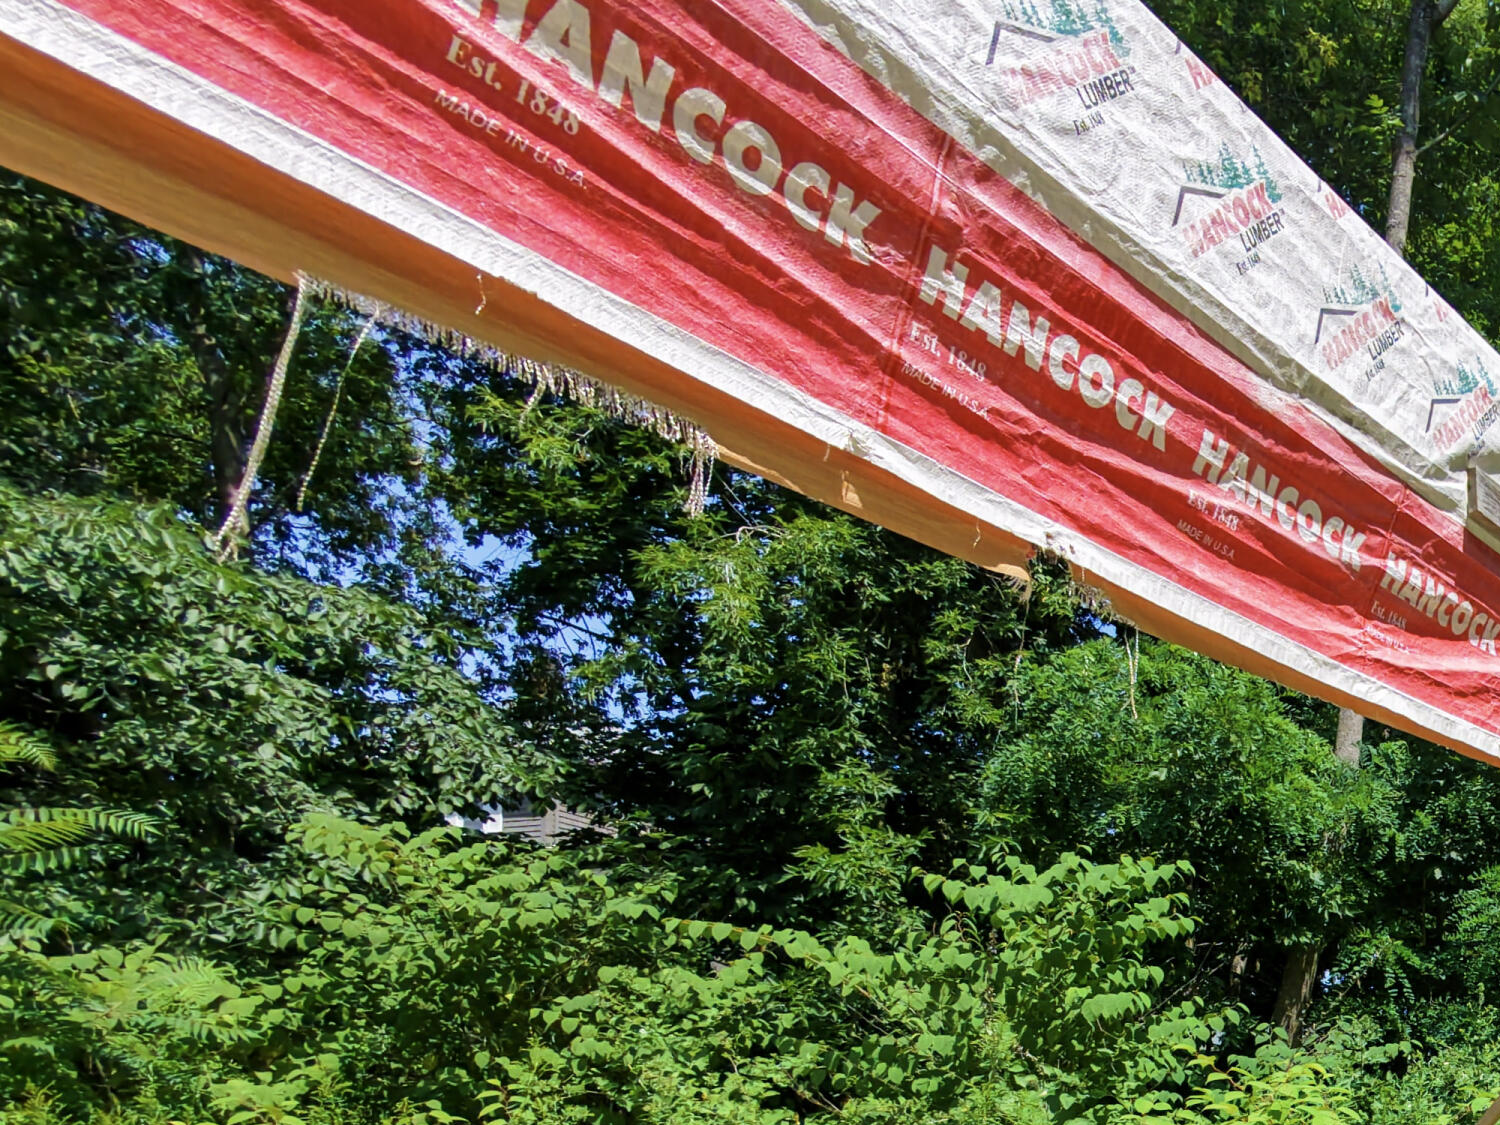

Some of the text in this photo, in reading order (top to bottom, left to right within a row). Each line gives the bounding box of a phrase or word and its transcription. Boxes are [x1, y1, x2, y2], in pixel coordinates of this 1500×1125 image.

[446, 34, 581, 136] Est. 1848
[435, 88, 502, 137] MADE
[504, 129, 529, 153] IN
[1239, 212, 1286, 252] LUMBER
[910, 321, 987, 382] Est. 1848
[918, 245, 1176, 452] HANCOCK
[1367, 320, 1405, 361] LUMBER
[901, 361, 942, 391] MADE
[942, 384, 957, 399] IN
[1192, 428, 1367, 572] HANCOCK
[1176, 519, 1202, 543] MADE
